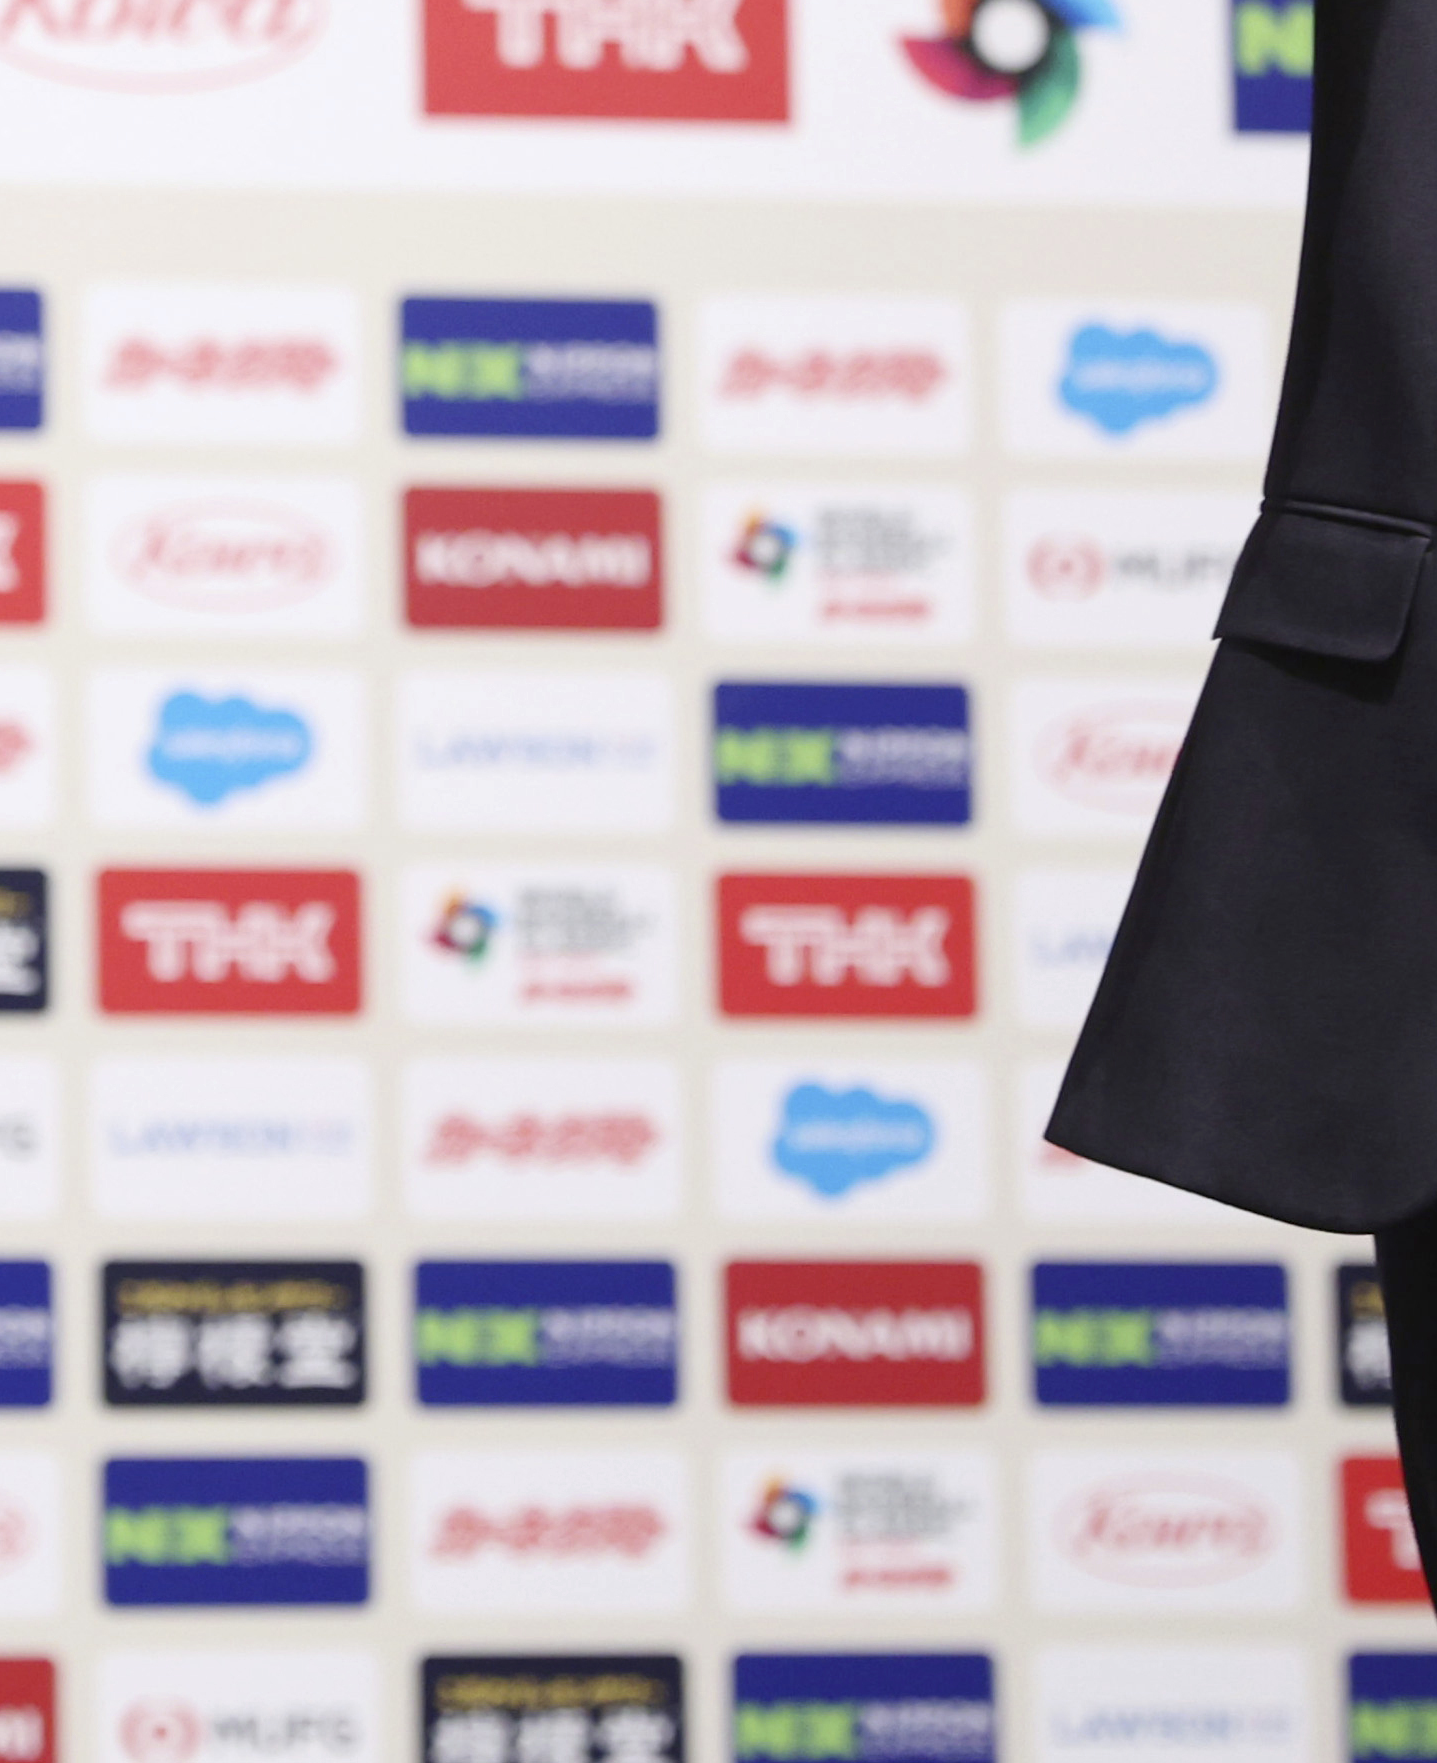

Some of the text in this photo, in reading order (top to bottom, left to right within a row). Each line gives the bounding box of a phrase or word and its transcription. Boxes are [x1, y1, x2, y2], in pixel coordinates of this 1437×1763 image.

[417, 531, 650, 587] KONAMI
[121, 901, 334, 982] THK
[740, 905, 949, 986] THK
[737, 1307, 973, 1362] KONAMI
